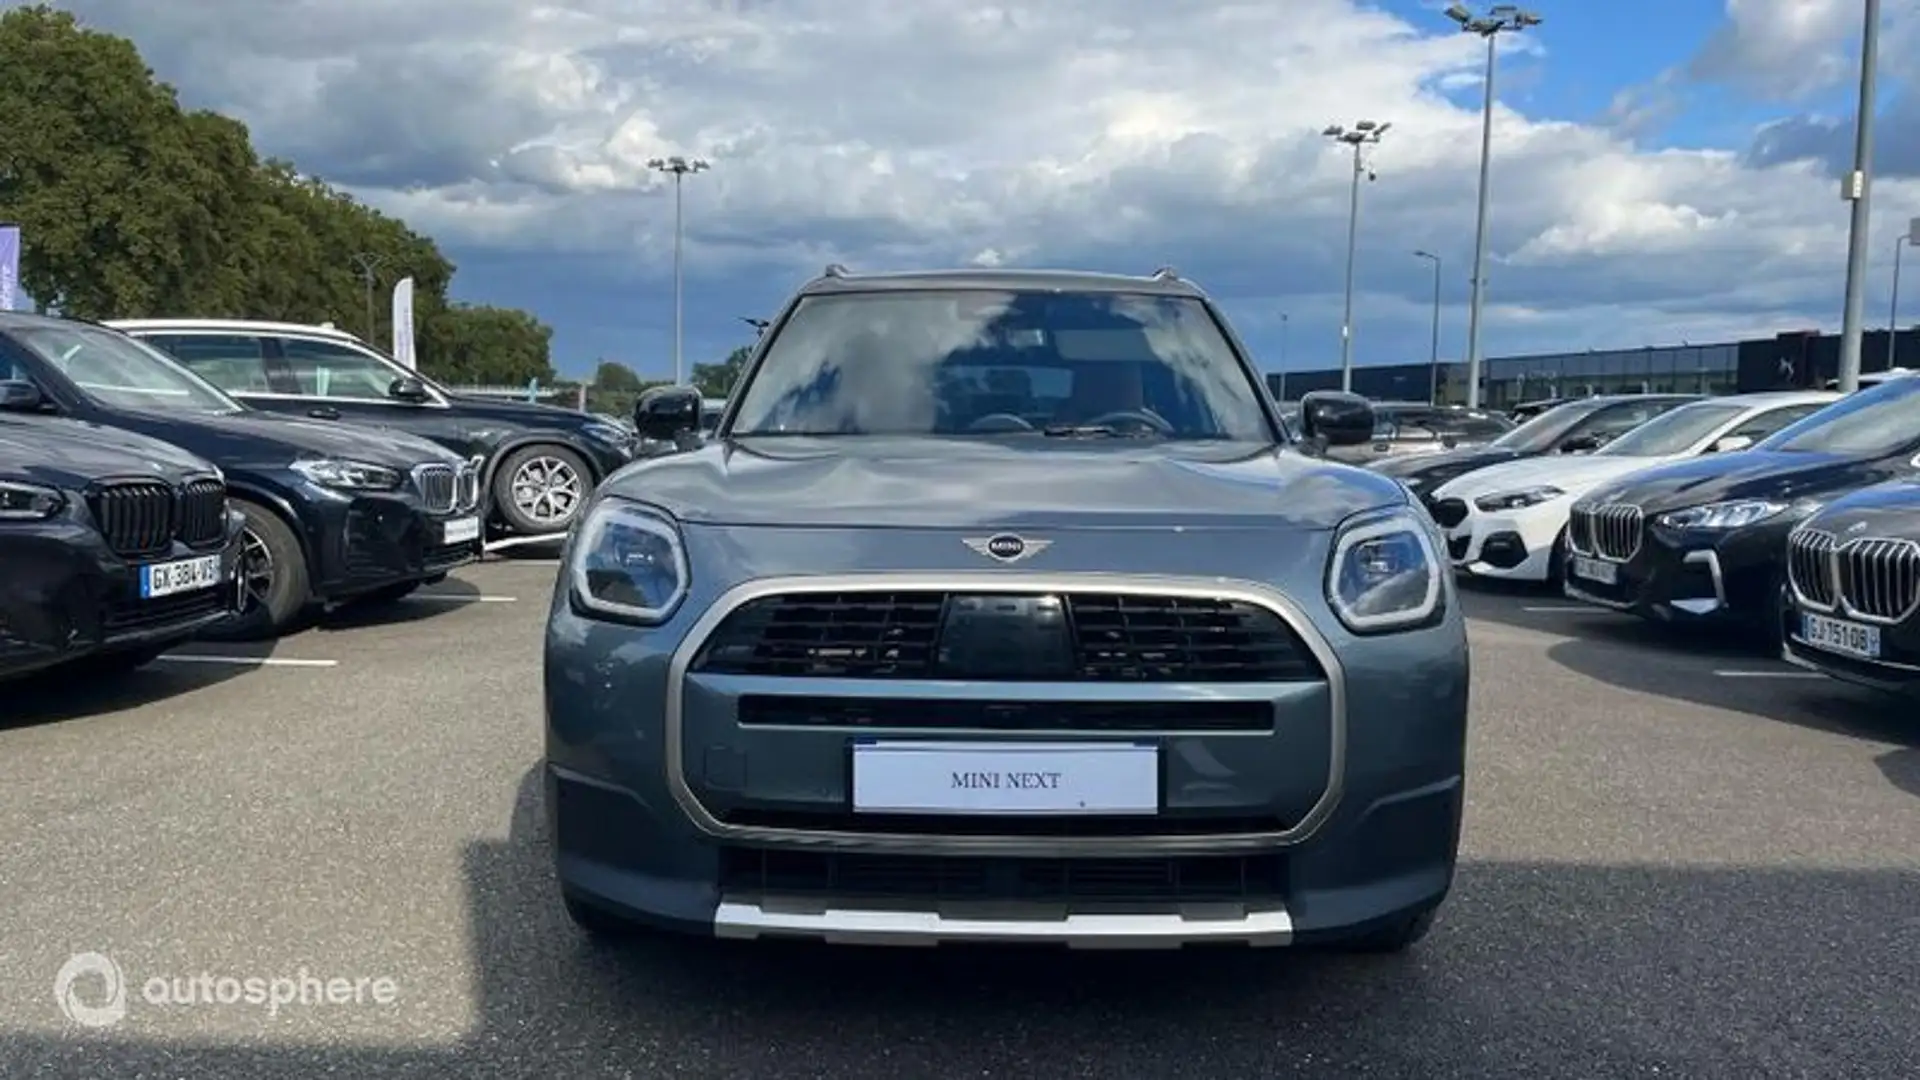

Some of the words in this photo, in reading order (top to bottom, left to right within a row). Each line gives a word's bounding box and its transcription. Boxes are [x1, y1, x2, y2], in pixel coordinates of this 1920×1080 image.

[990, 541, 1022, 551] MINI
[951, 771, 1000, 789] MINI
[1007, 771, 1062, 789] NEXT
